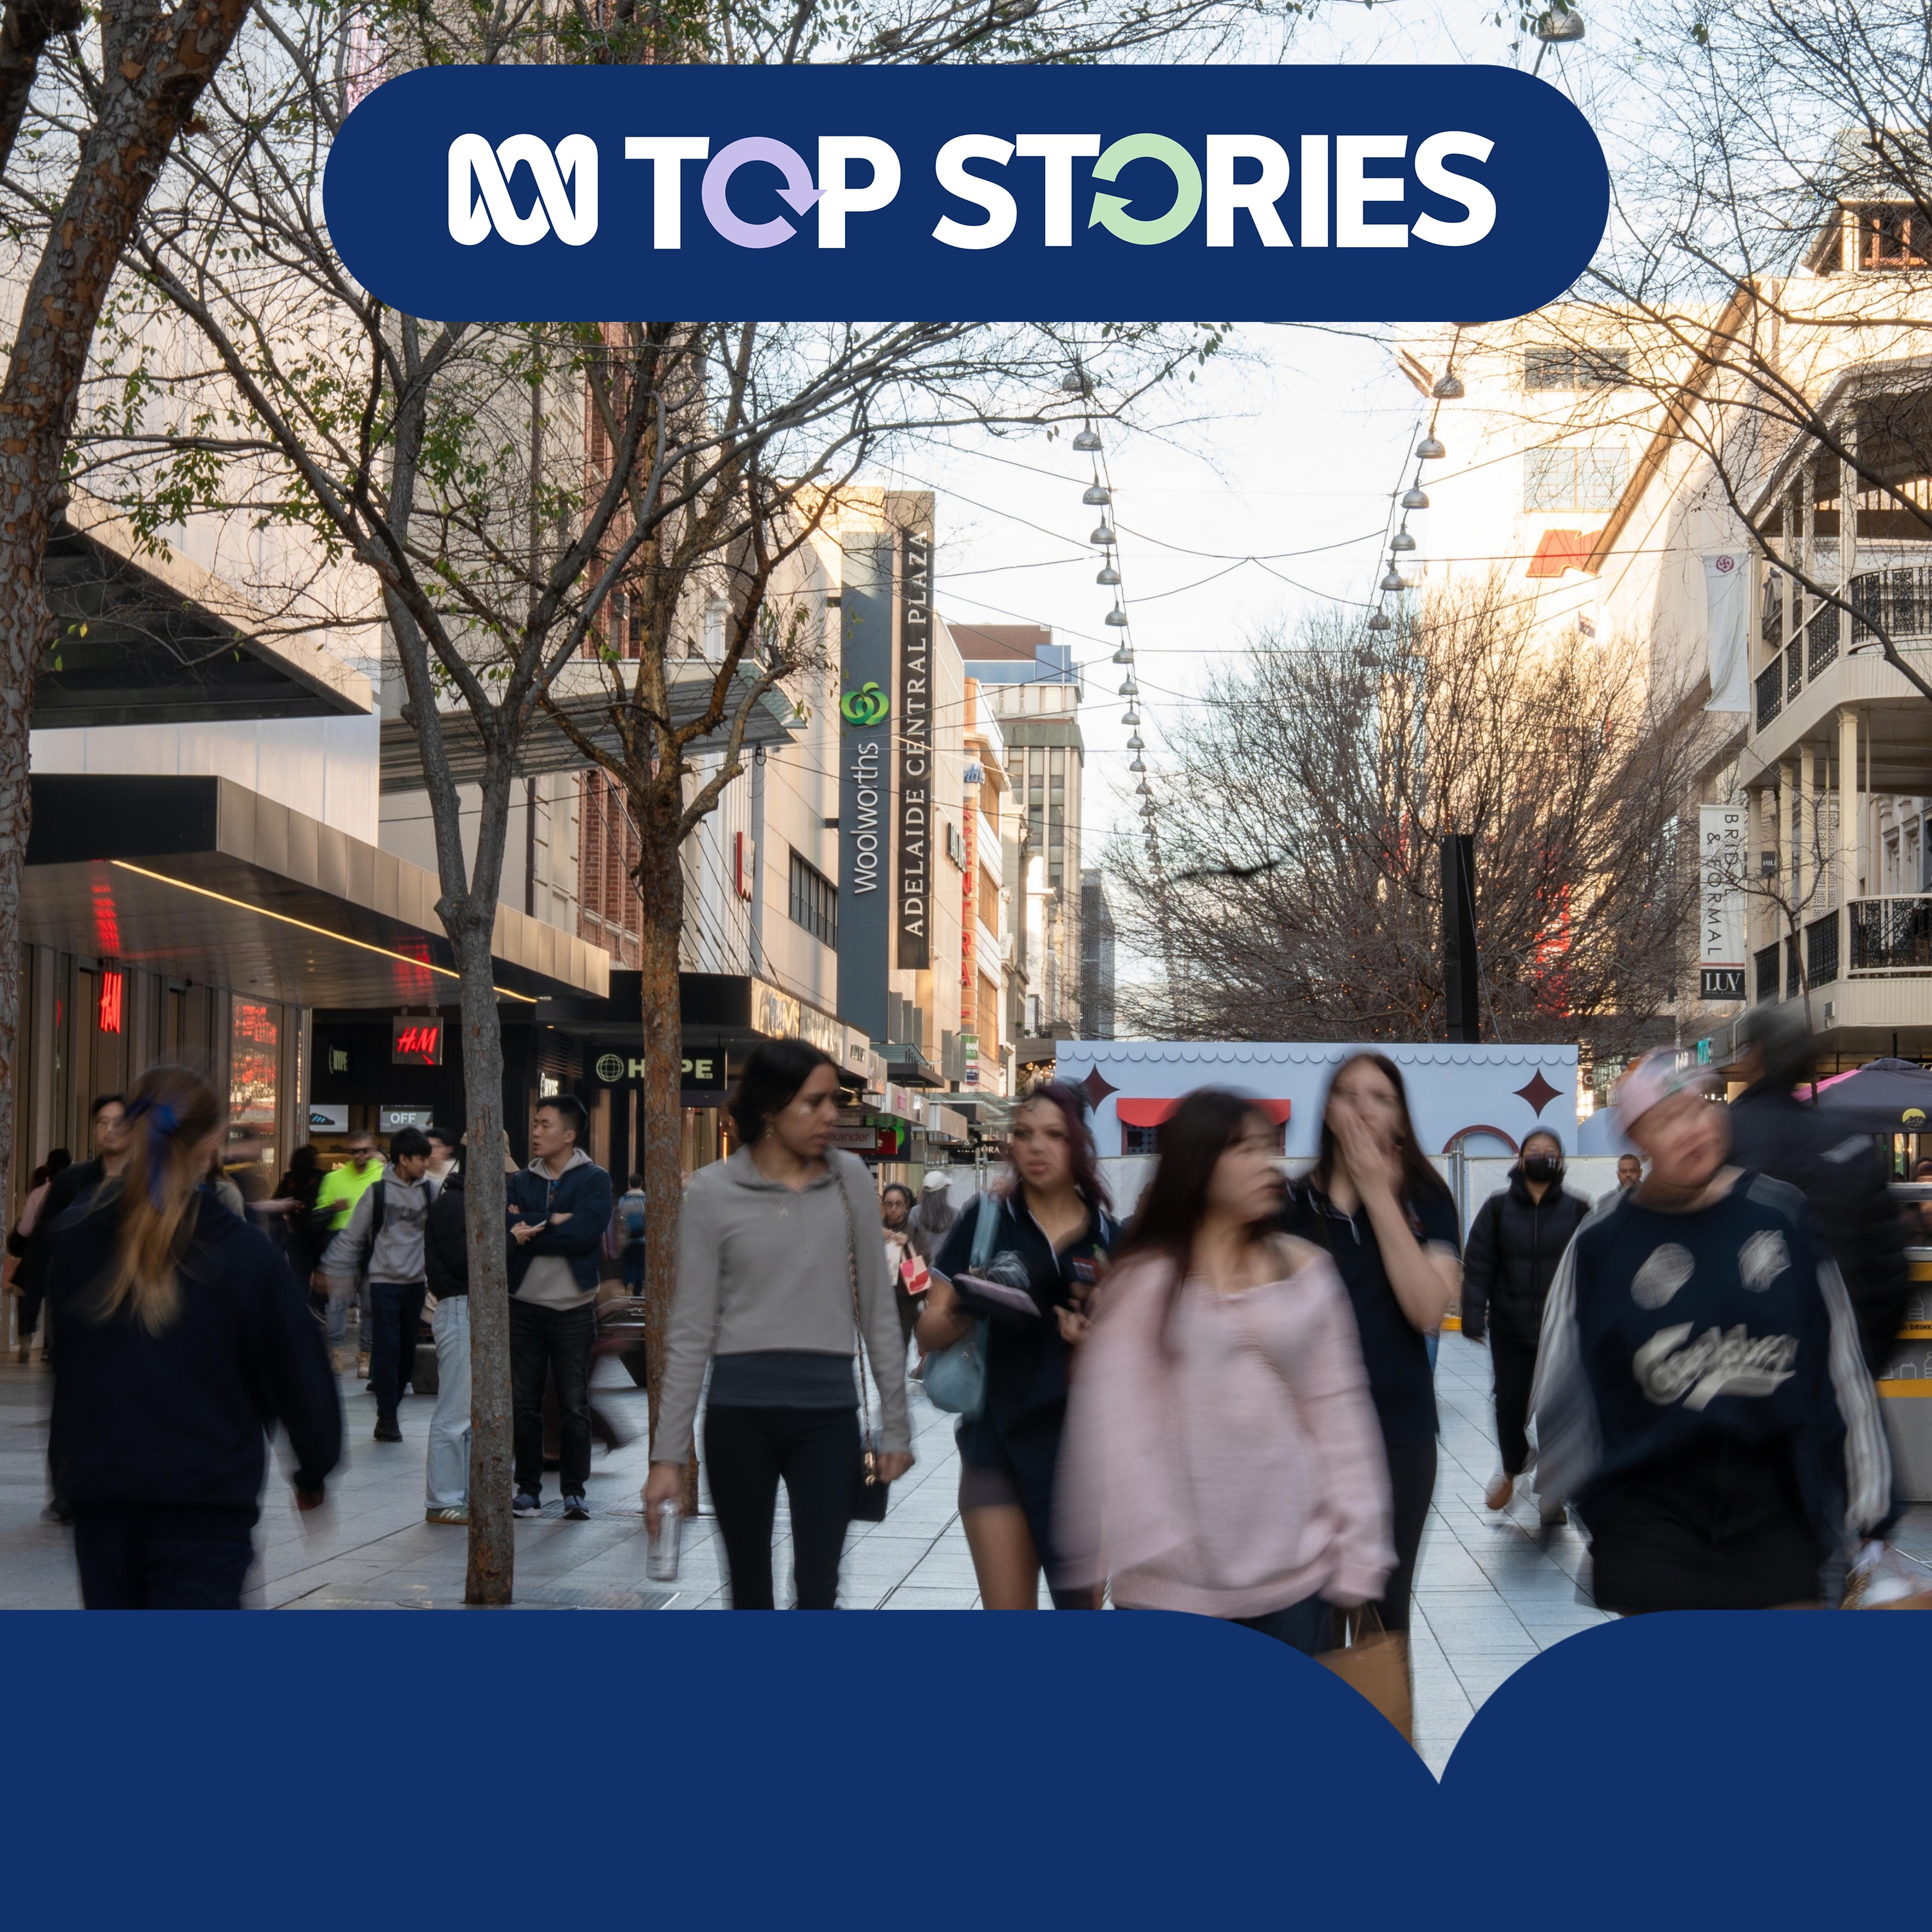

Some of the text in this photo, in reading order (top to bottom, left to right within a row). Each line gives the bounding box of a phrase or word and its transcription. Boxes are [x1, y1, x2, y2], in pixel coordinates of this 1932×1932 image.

[905, 530, 927, 938] ADELAIDE CENTRAL PLAZA
[850, 742, 879, 895] Woolworths
[1707, 833, 1722, 955] & FORMAL
[1705, 973, 1741, 991] LUV
[397, 1027, 439, 1054] H&M
[628, 1058, 713, 1079] HPE
[390, 1113, 417, 1123] OFF
